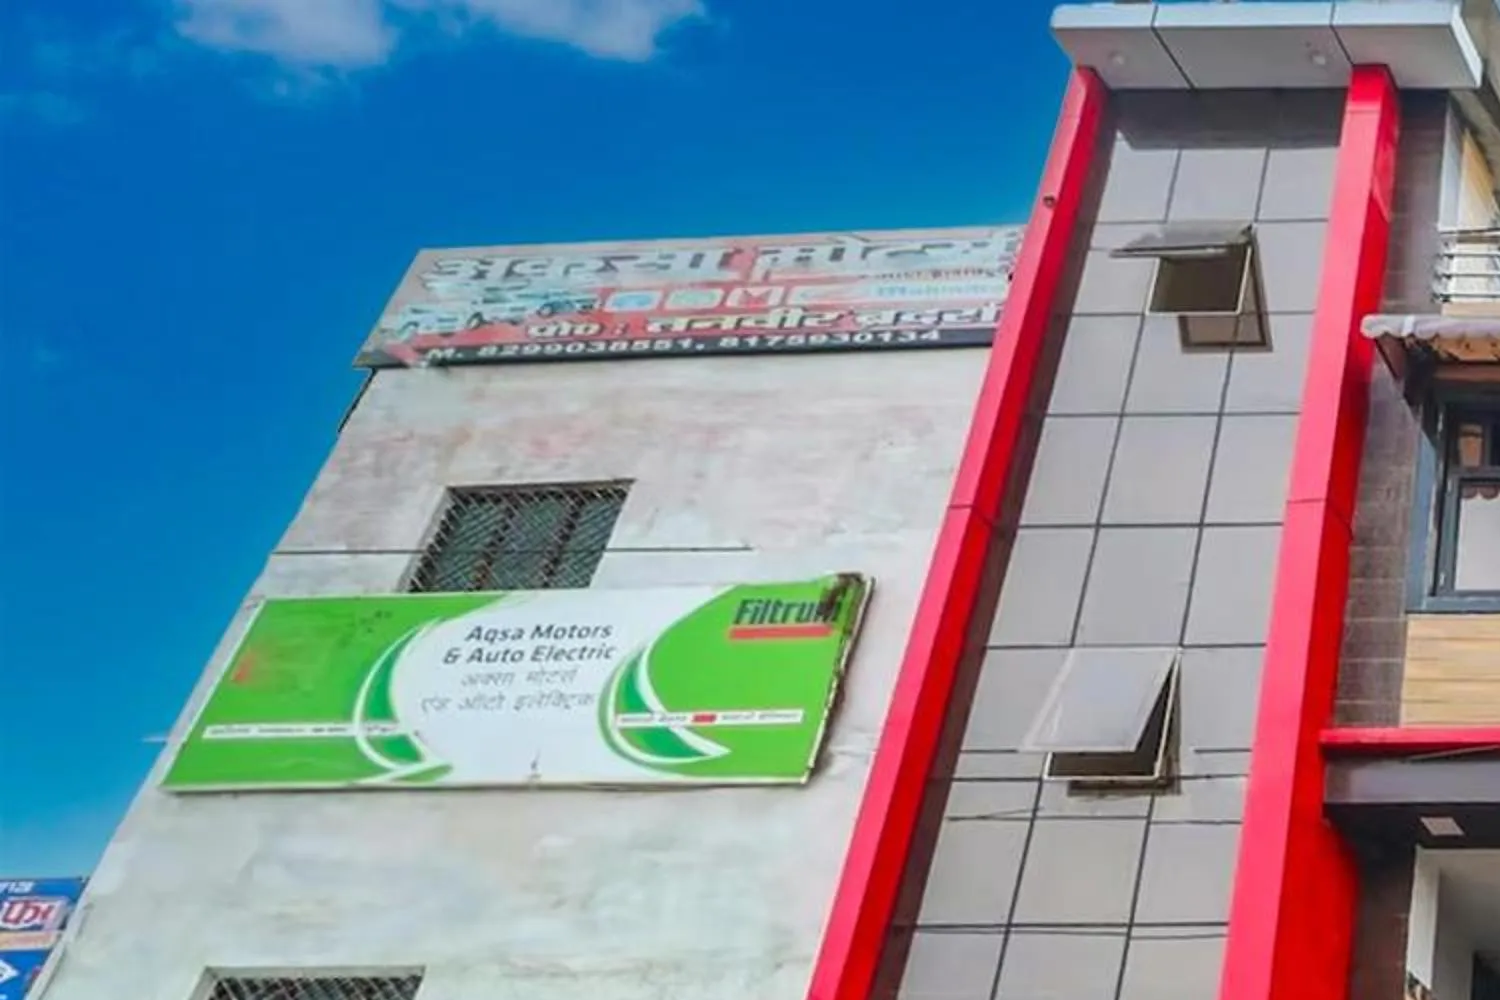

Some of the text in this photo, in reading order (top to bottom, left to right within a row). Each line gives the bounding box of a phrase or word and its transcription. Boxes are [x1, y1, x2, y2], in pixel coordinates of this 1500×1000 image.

[465, 624, 613, 644] Aqsa Motors
[466, 647, 525, 664] Auto
[530, 643, 615, 662] Electric
